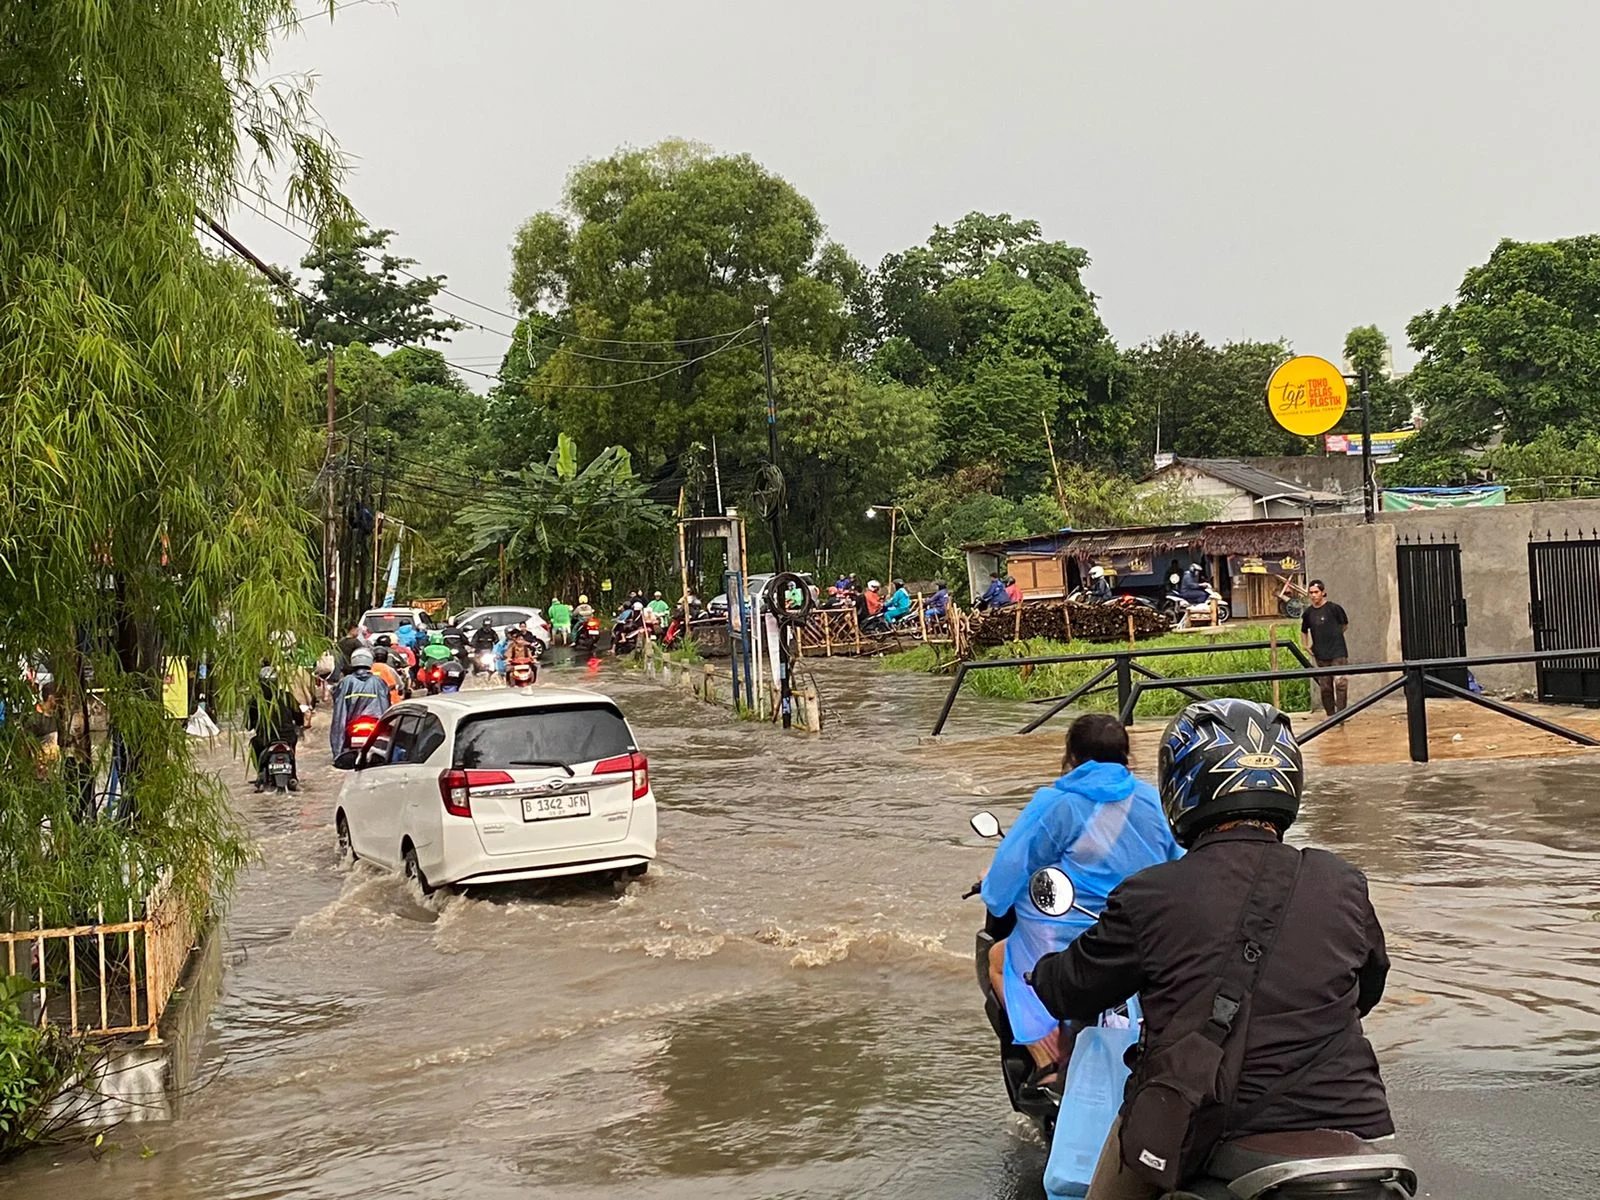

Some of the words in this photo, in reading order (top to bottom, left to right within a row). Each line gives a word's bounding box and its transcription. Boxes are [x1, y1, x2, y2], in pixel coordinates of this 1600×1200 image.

[1307, 378, 1328, 388] TOKO
[1273, 381, 1306, 410] tgp
[1309, 387, 1332, 397] GELAS
[1310, 395, 1341, 407] PLASTIK
[525, 801, 533, 813] B
[537, 798, 563, 811] 1342
[568, 795, 587, 808] JFN
